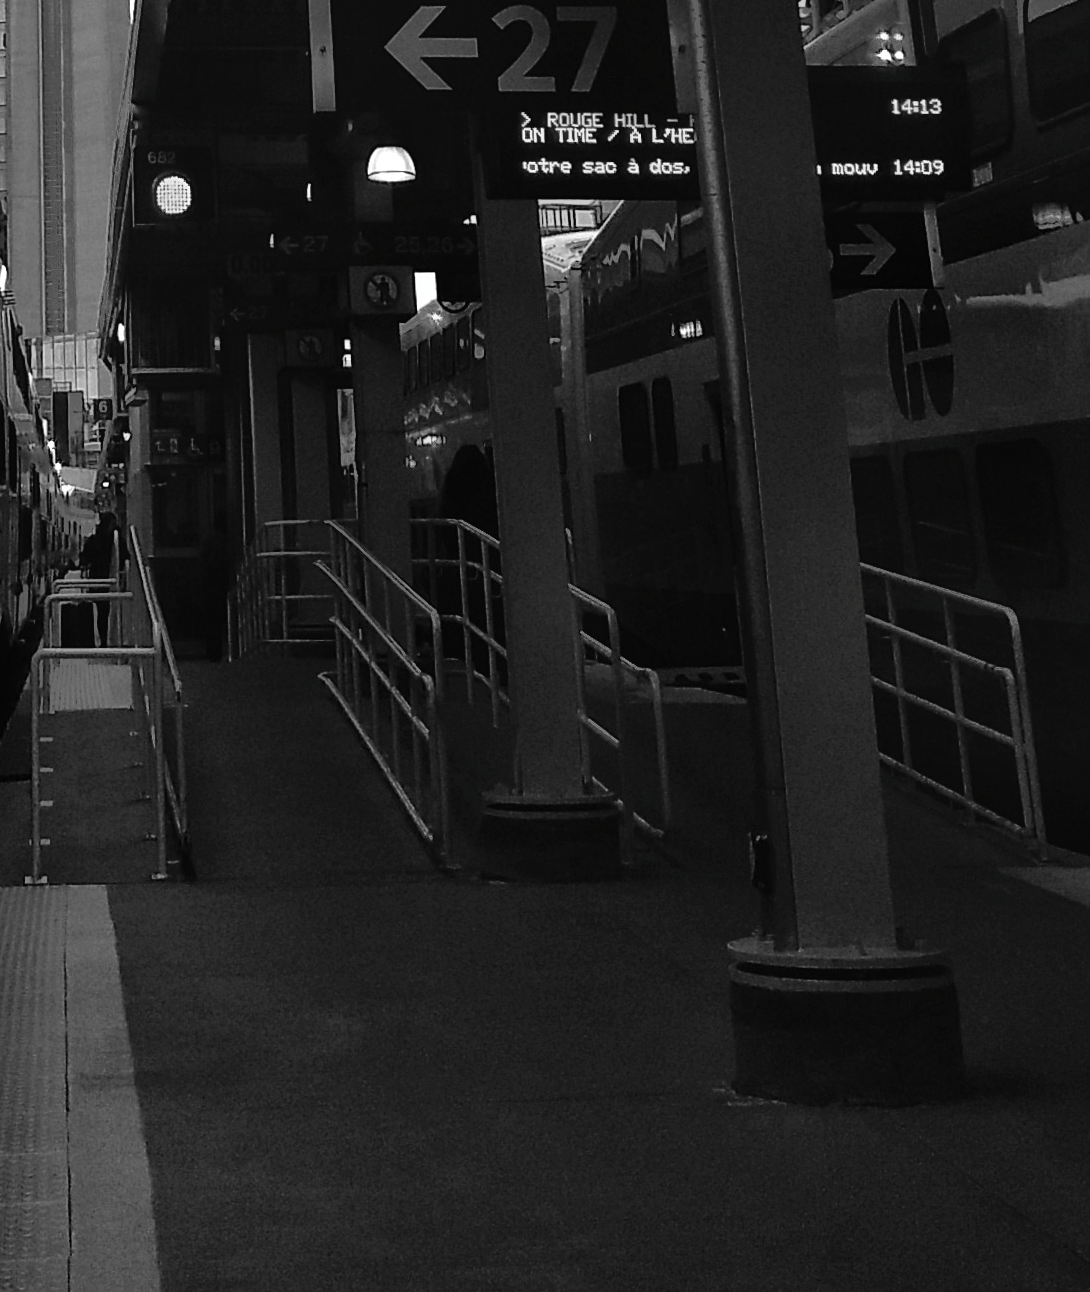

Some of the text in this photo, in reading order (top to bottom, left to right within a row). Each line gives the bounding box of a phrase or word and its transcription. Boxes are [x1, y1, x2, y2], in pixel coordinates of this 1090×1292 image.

[490, 3, 618, 93] 27
[890, 97, 943, 115] 14:13
[546, 111, 605, 129] ROUGE
[613, 112, 657, 129] HILL
[521, 127, 546, 144] ON
[554, 127, 598, 144] TIME
[651, 127, 698, 145] L'HE
[581, 160, 618, 175] sac
[648, 157, 691, 175] dos,
[893, 158, 945, 176] 14:09
[302, 235, 329, 253] 27
